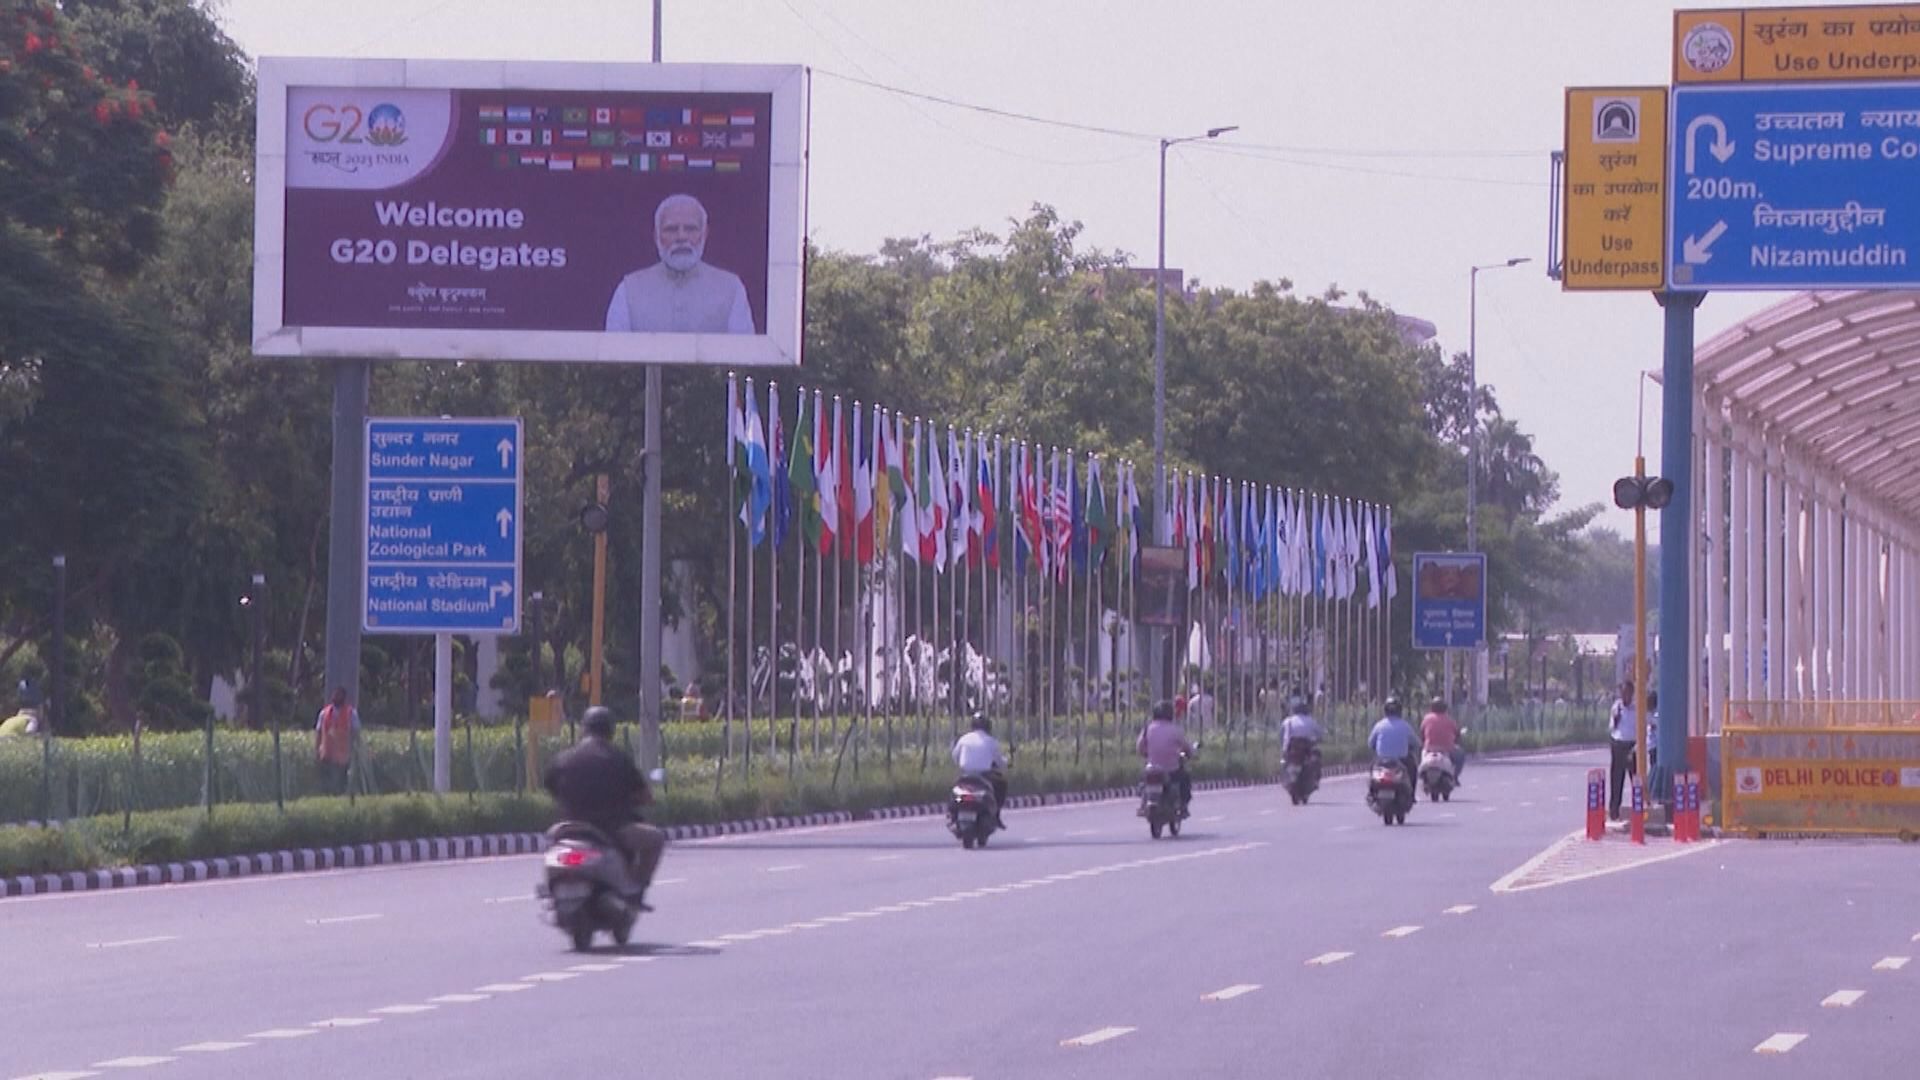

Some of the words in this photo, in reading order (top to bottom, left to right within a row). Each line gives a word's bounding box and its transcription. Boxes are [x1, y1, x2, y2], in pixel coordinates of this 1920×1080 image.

[1754, 17, 1808, 45] सुरंग
[1823, 21, 1855, 36] का
[1775, 53, 1819, 71] Use
[1828, 51, 1920, 72] Underp
[1755, 111, 1845, 130] उच्चतम
[376, 153, 410, 165] INDIA
[1754, 138, 1872, 165] Supreme
[1880, 136, 1920, 159] Co
[1600, 150, 1637, 172] सुरंग
[1574, 183, 1594, 195] का
[1605, 178, 1658, 195] उपयोग
[1687, 179, 1763, 199] 200m.
[374, 201, 524, 229] Welcome
[1753, 200, 1885, 234] निजामुद्दीन
[1602, 234, 1633, 251] Use
[330, 238, 397, 264] G20
[407, 240, 567, 271] Delegates
[1751, 244, 1906, 267] Nizamuddin
[1570, 259, 1659, 277] Underpass
[372, 453, 425, 467] Sunder
[429, 453, 474, 469] Nagar
[370, 524, 432, 538] National
[370, 542, 449, 559] Zoological
[453, 543, 487, 557] Park
[368, 597, 427, 612] National
[431, 598, 490, 613] Stadium
[1765, 767, 1813, 786] DELHI
[1821, 767, 1881, 787] POLICE
